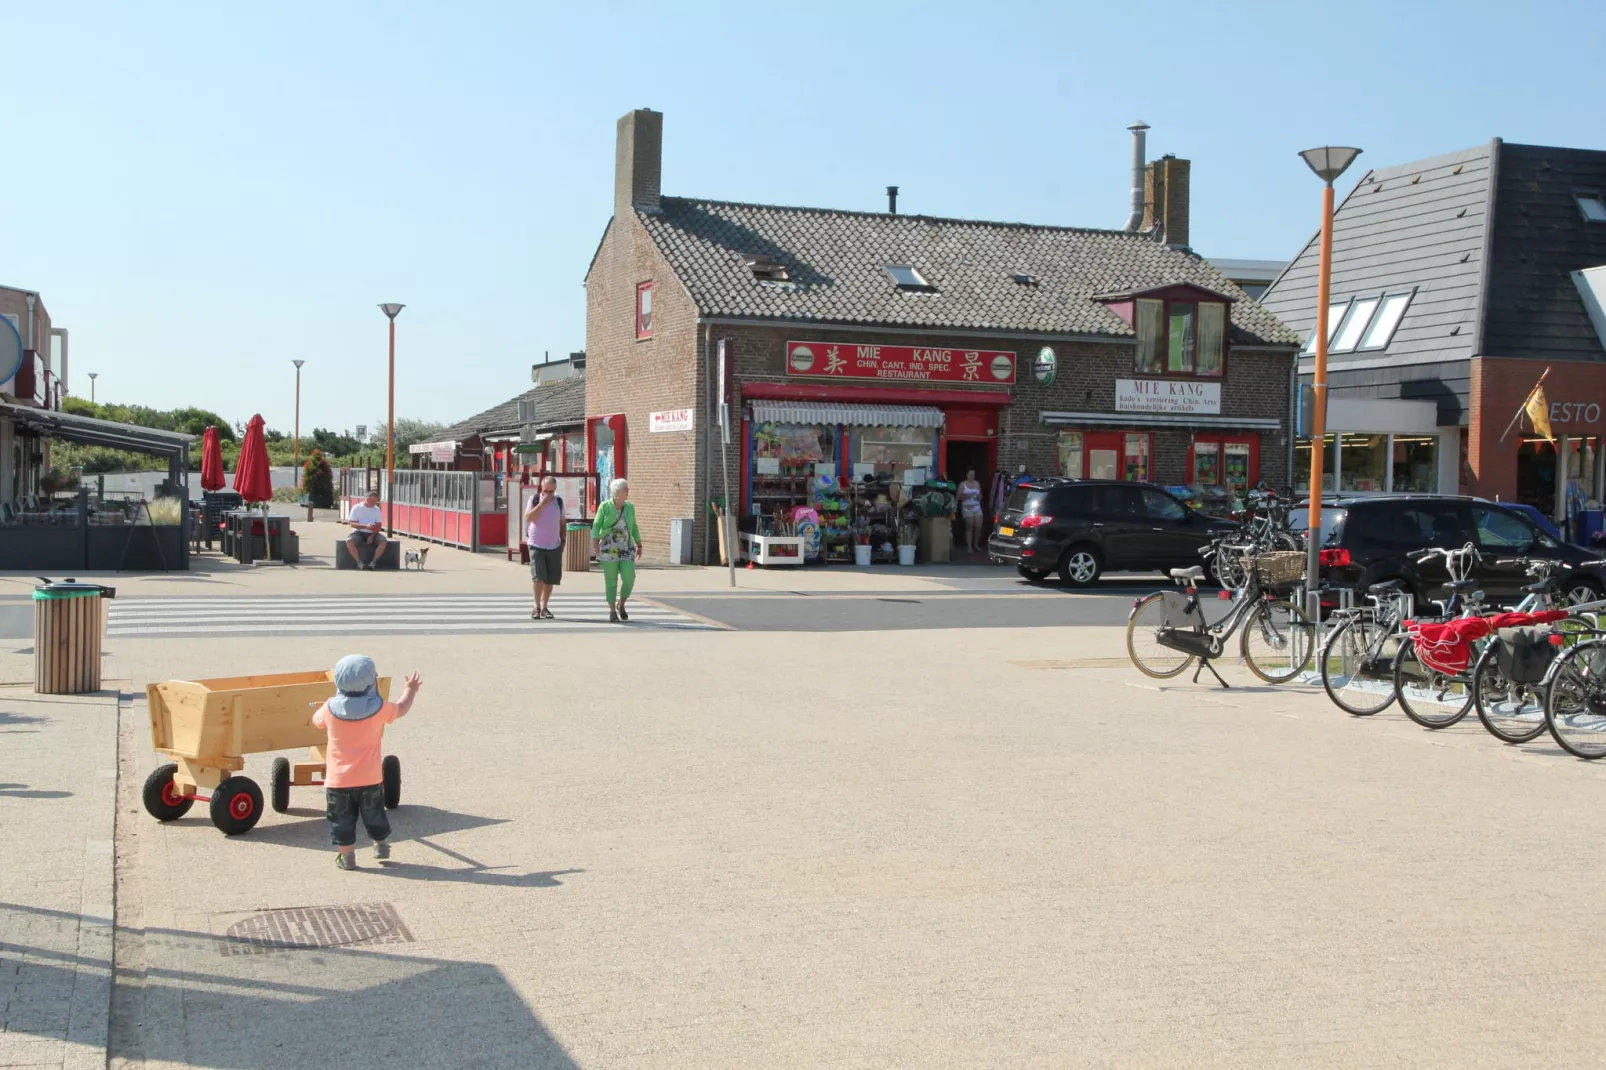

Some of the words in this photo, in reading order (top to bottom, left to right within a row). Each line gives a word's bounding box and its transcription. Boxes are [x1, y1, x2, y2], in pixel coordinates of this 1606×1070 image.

[823, 345, 848, 374] 美
[857, 346, 880, 359] MIE
[913, 349, 952, 362] KANG
[857, 359, 878, 368] CHIN.
[882, 361, 906, 370] CANT.
[909, 362, 925, 371] IND.
[928, 363, 952, 372] SPEC.
[959, 351, 983, 381] 景
[877, 369, 931, 379] RESTAURANT
[1134, 381, 1159, 394] MIE
[1169, 382, 1203, 396] KANG
